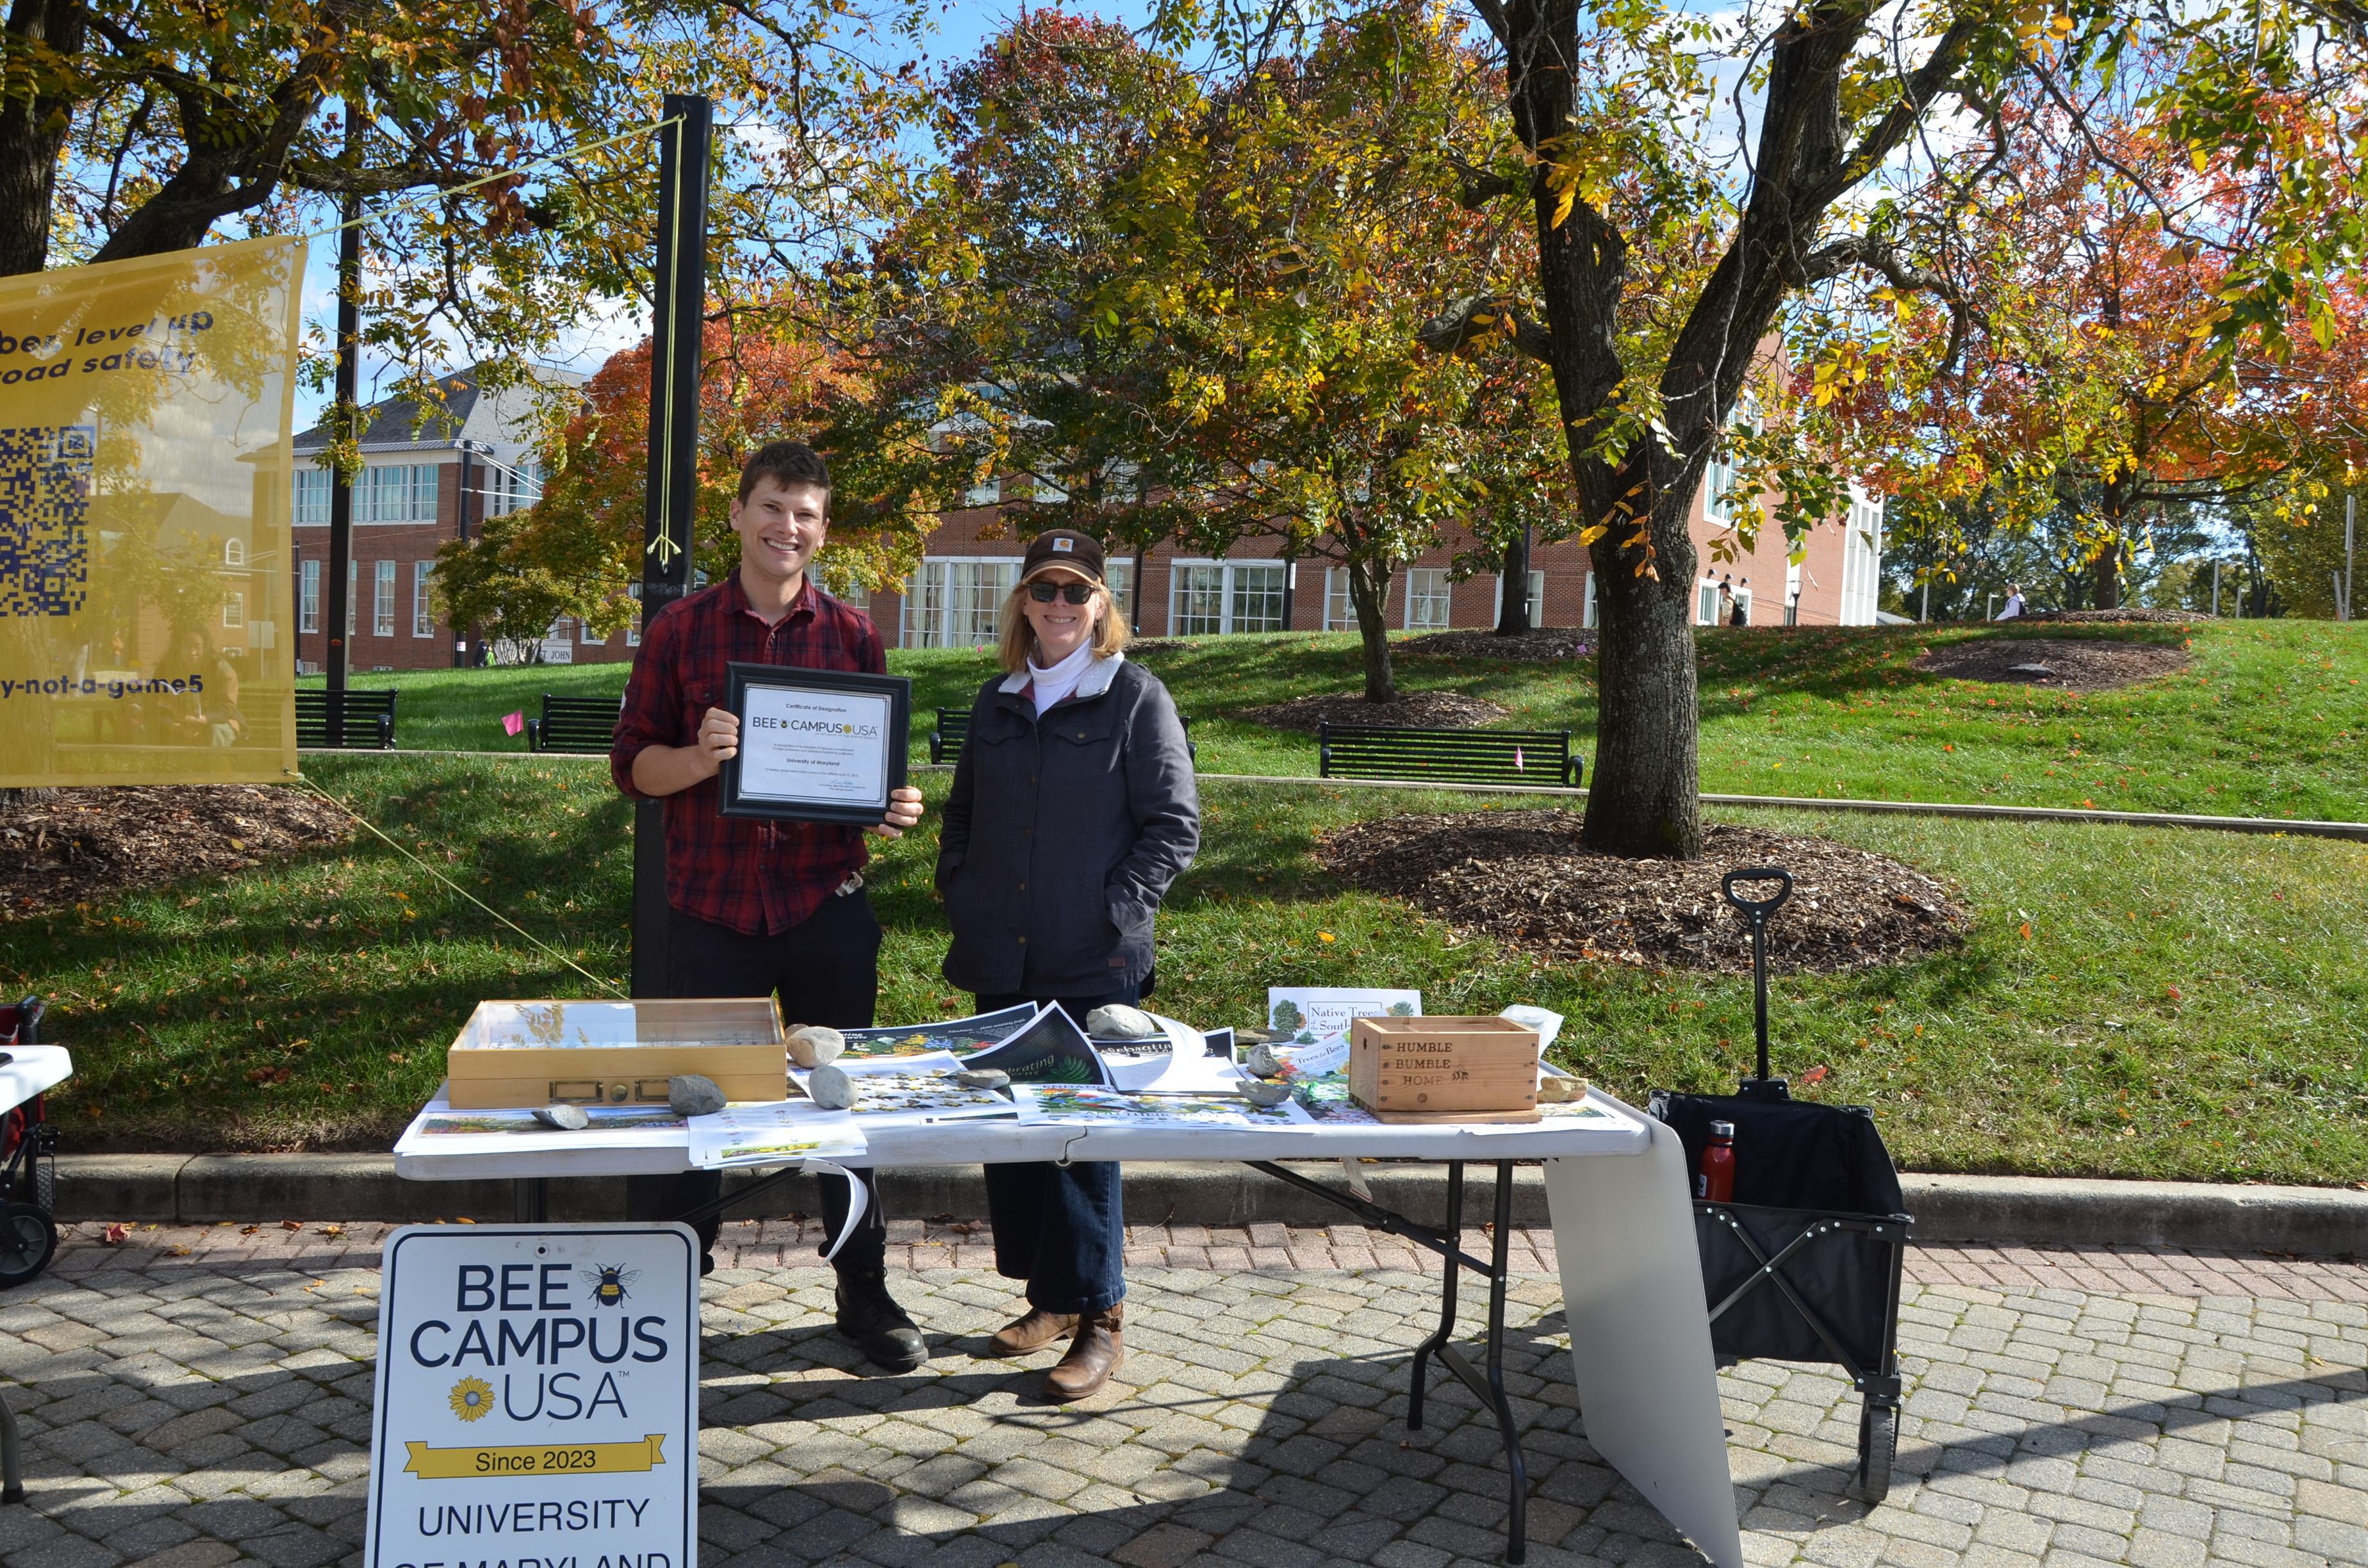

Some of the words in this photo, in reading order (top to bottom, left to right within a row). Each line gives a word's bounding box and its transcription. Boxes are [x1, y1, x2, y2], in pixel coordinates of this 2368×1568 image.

[74, 318, 158, 347] level
[169, 311, 214, 336] up
[0, 359, 72, 384] oad
[550, 650, 570, 660] JOHN
[752, 717, 777, 728] BEE
[791, 720, 843, 733] CAMPUS
[1311, 1007, 1345, 1017] Native
[1295, 1055, 1319, 1064] Trees
[1326, 1045, 1345, 1055] Bees
[1397, 1042, 1453, 1052] HUMBLE
[1395, 1059, 1451, 1069] BUMBLE
[1403, 1075, 1443, 1086] HOME
[456, 1263, 572, 1312] BEE
[409, 1316, 668, 1368] CAMPUS
[475, 1452, 536, 1471] Since
[543, 1450, 596, 1469] 2023
[418, 1498, 650, 1537] UNIVERSITY
